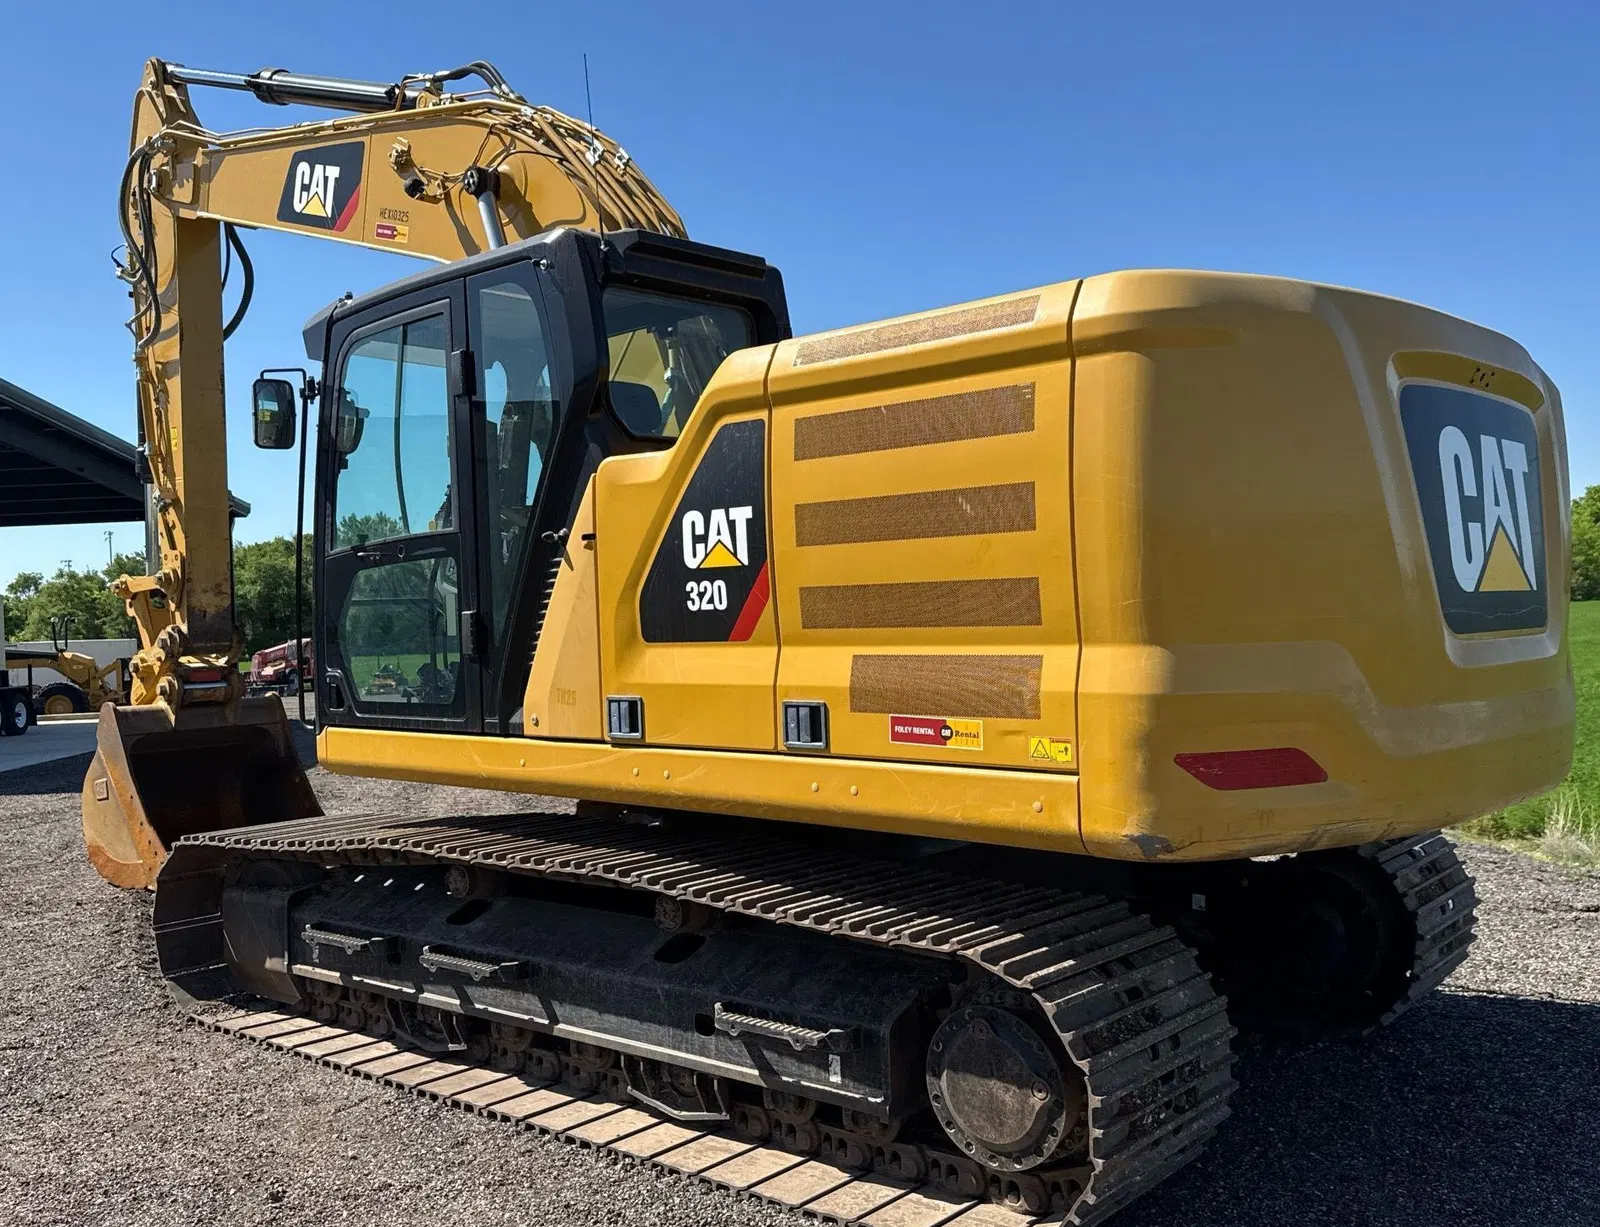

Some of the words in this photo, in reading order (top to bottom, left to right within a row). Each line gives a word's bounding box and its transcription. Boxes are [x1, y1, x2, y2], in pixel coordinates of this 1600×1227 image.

[293, 161, 340, 218] CAT
[1438, 425, 1537, 592] CAT
[682, 505, 752, 569] CAT
[685, 580, 727, 611] 320
[894, 725, 912, 734] FOLEY
[912, 727, 935, 736] RENTAL
[941, 728, 951, 737] CAT
[954, 730, 979, 739] Rental
